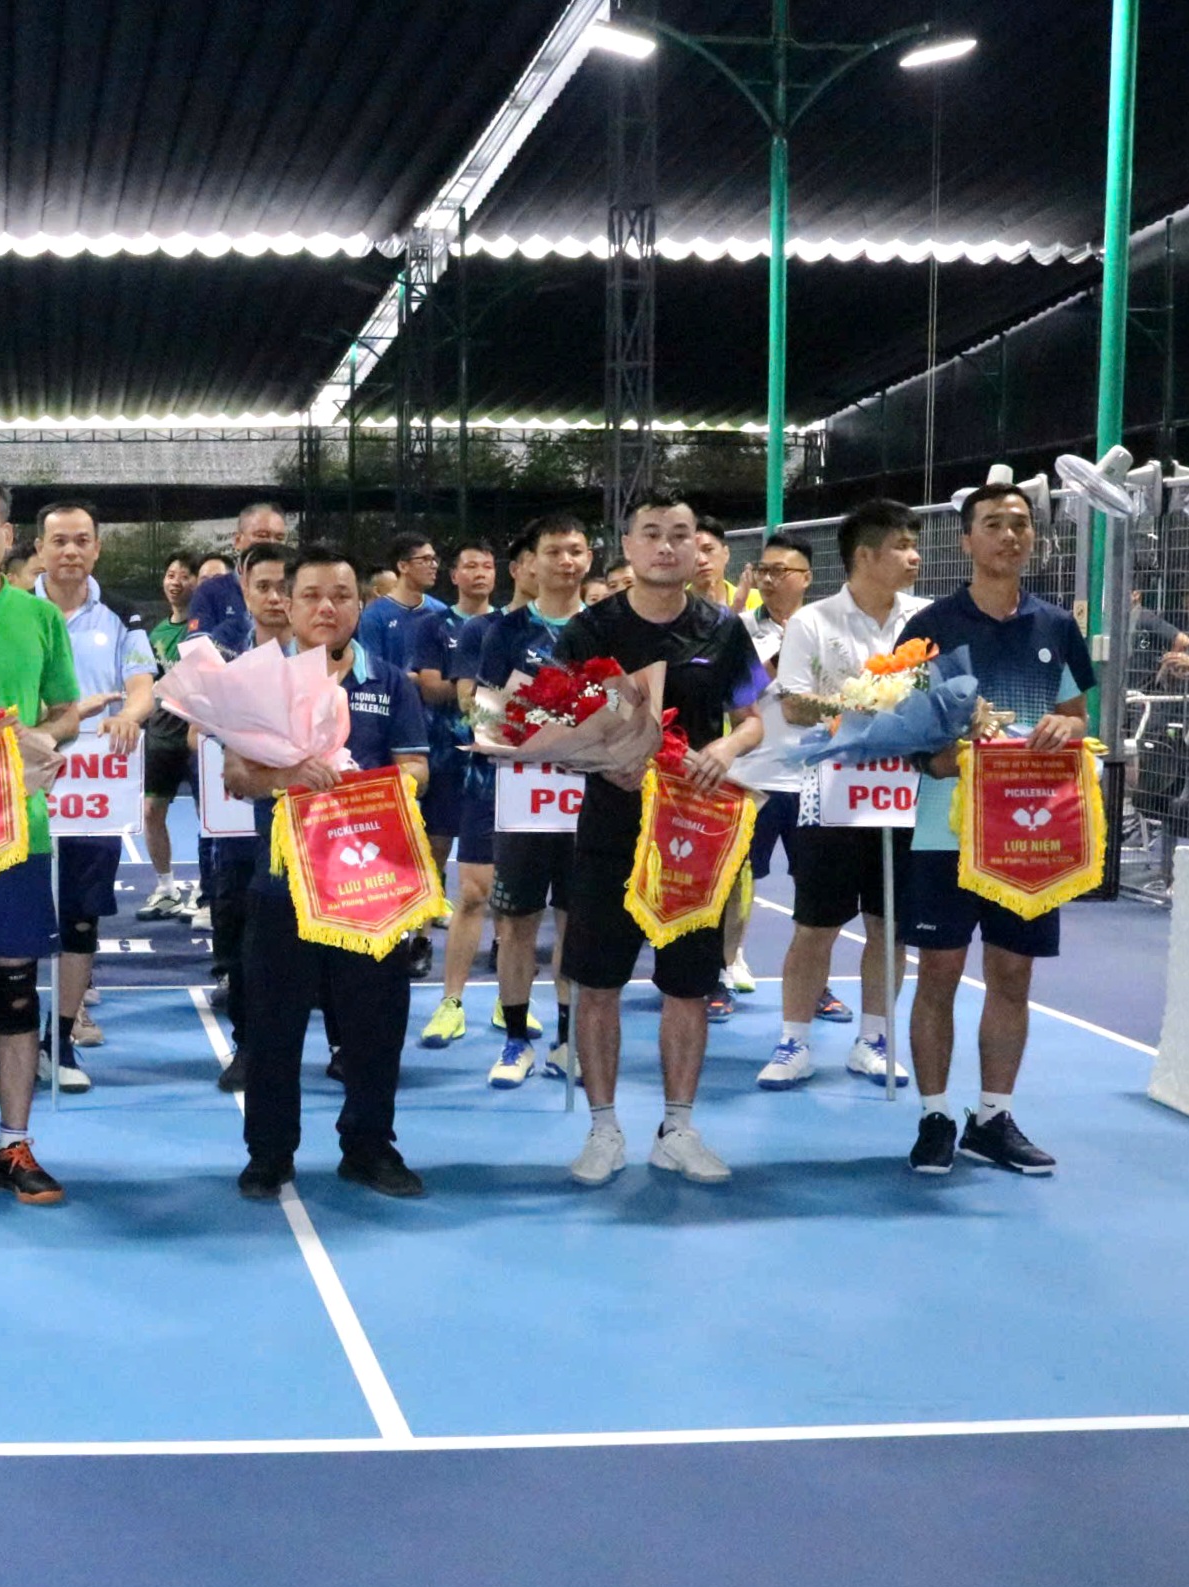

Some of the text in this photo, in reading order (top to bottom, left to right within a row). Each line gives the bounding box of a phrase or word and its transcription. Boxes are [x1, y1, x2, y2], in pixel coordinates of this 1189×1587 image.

[530, 788, 584, 815] PC
[848, 785, 918, 811] PC0
[1004, 788, 1057, 798] PICKLEBALL
[327, 820, 381, 839] PICKLEBALL
[1031, 837, 1061, 853] NIỆM
[365, 871, 397, 890] NIỆM
